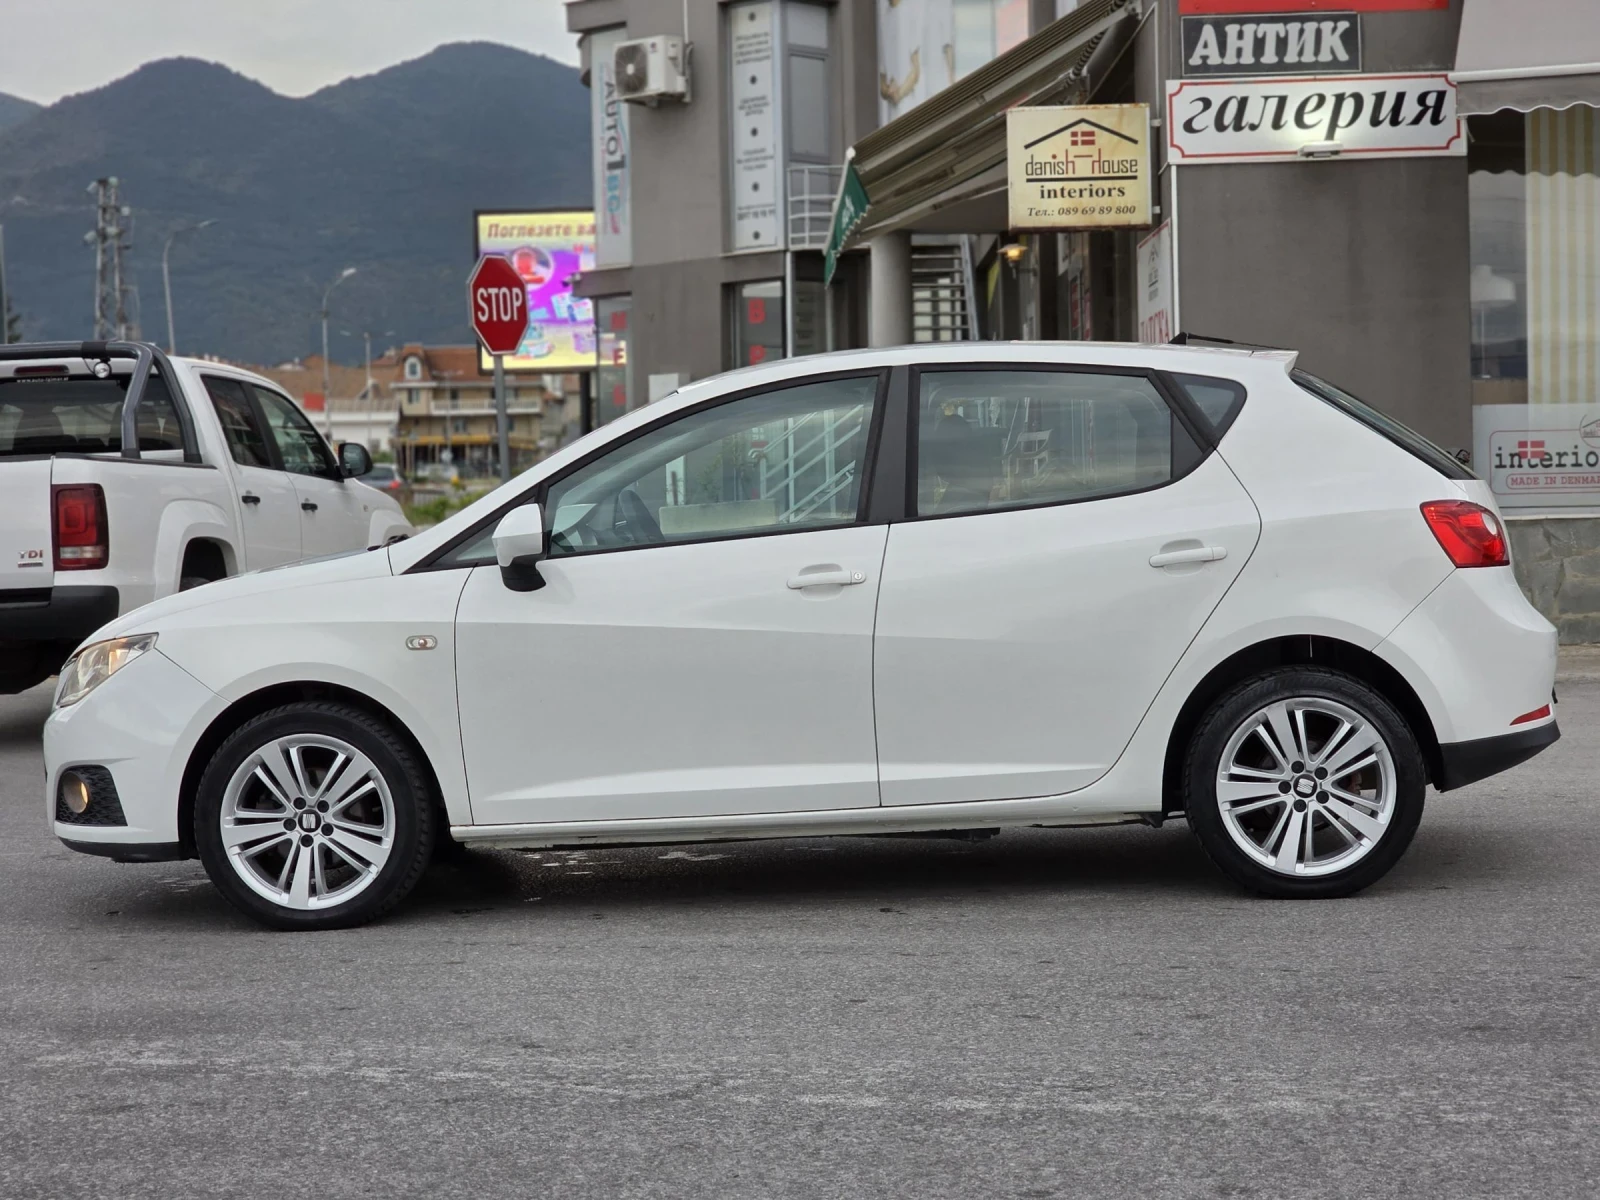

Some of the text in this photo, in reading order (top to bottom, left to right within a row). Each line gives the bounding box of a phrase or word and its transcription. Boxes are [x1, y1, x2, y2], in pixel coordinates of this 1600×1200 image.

[1188, 20, 1350, 66] АНТИК
[1182, 86, 1448, 142] галерия
[1025, 149, 1076, 176] danish
[1040, 184, 1126, 199] interiors
[1027, 205, 1137, 217] Тел.: 089 69 89 800
[477, 287, 523, 322] STOP
[1510, 476, 1540, 486] MADE
[1544, 476, 1557, 485] IN
[18, 549, 43, 559] TDI
